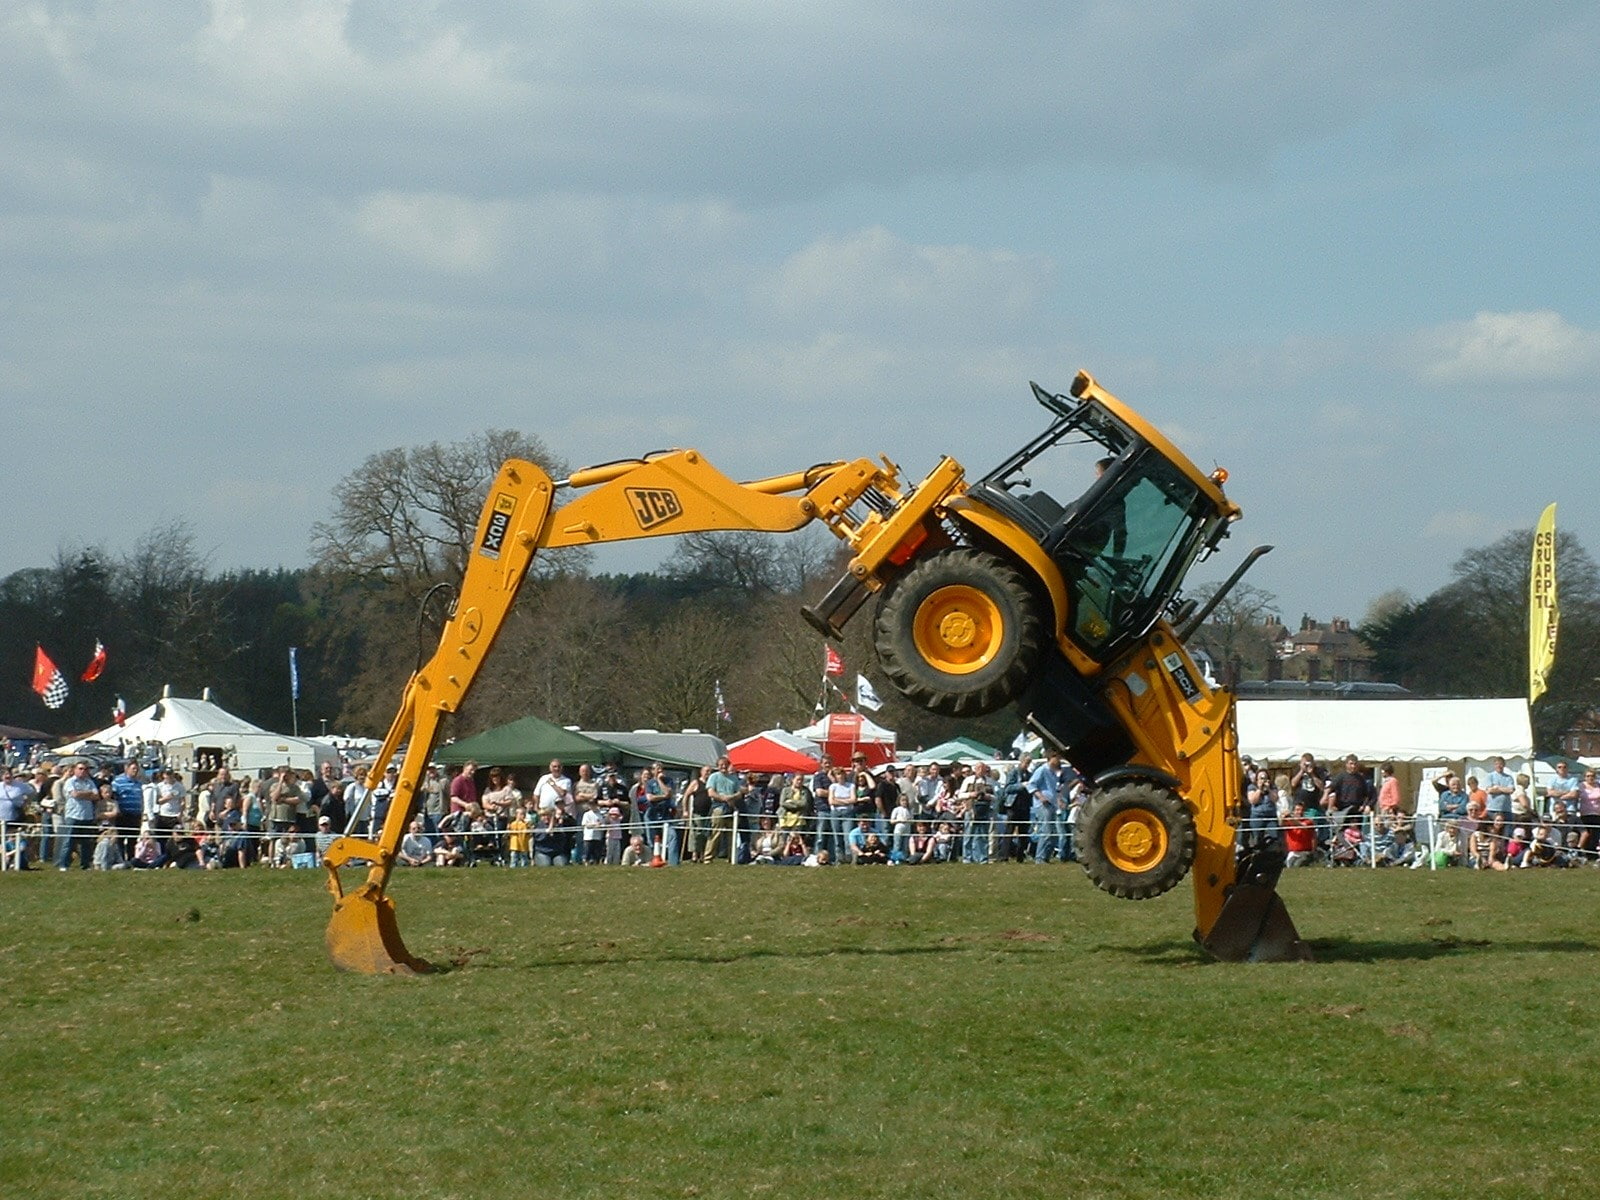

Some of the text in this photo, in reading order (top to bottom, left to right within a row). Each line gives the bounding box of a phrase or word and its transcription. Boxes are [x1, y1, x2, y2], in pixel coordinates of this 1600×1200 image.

[634, 491, 678, 525] JCB
[485, 515, 507, 548] 3CX
[1535, 533, 1544, 609] CRAFT
[1174, 668, 1195, 696] 3CX
